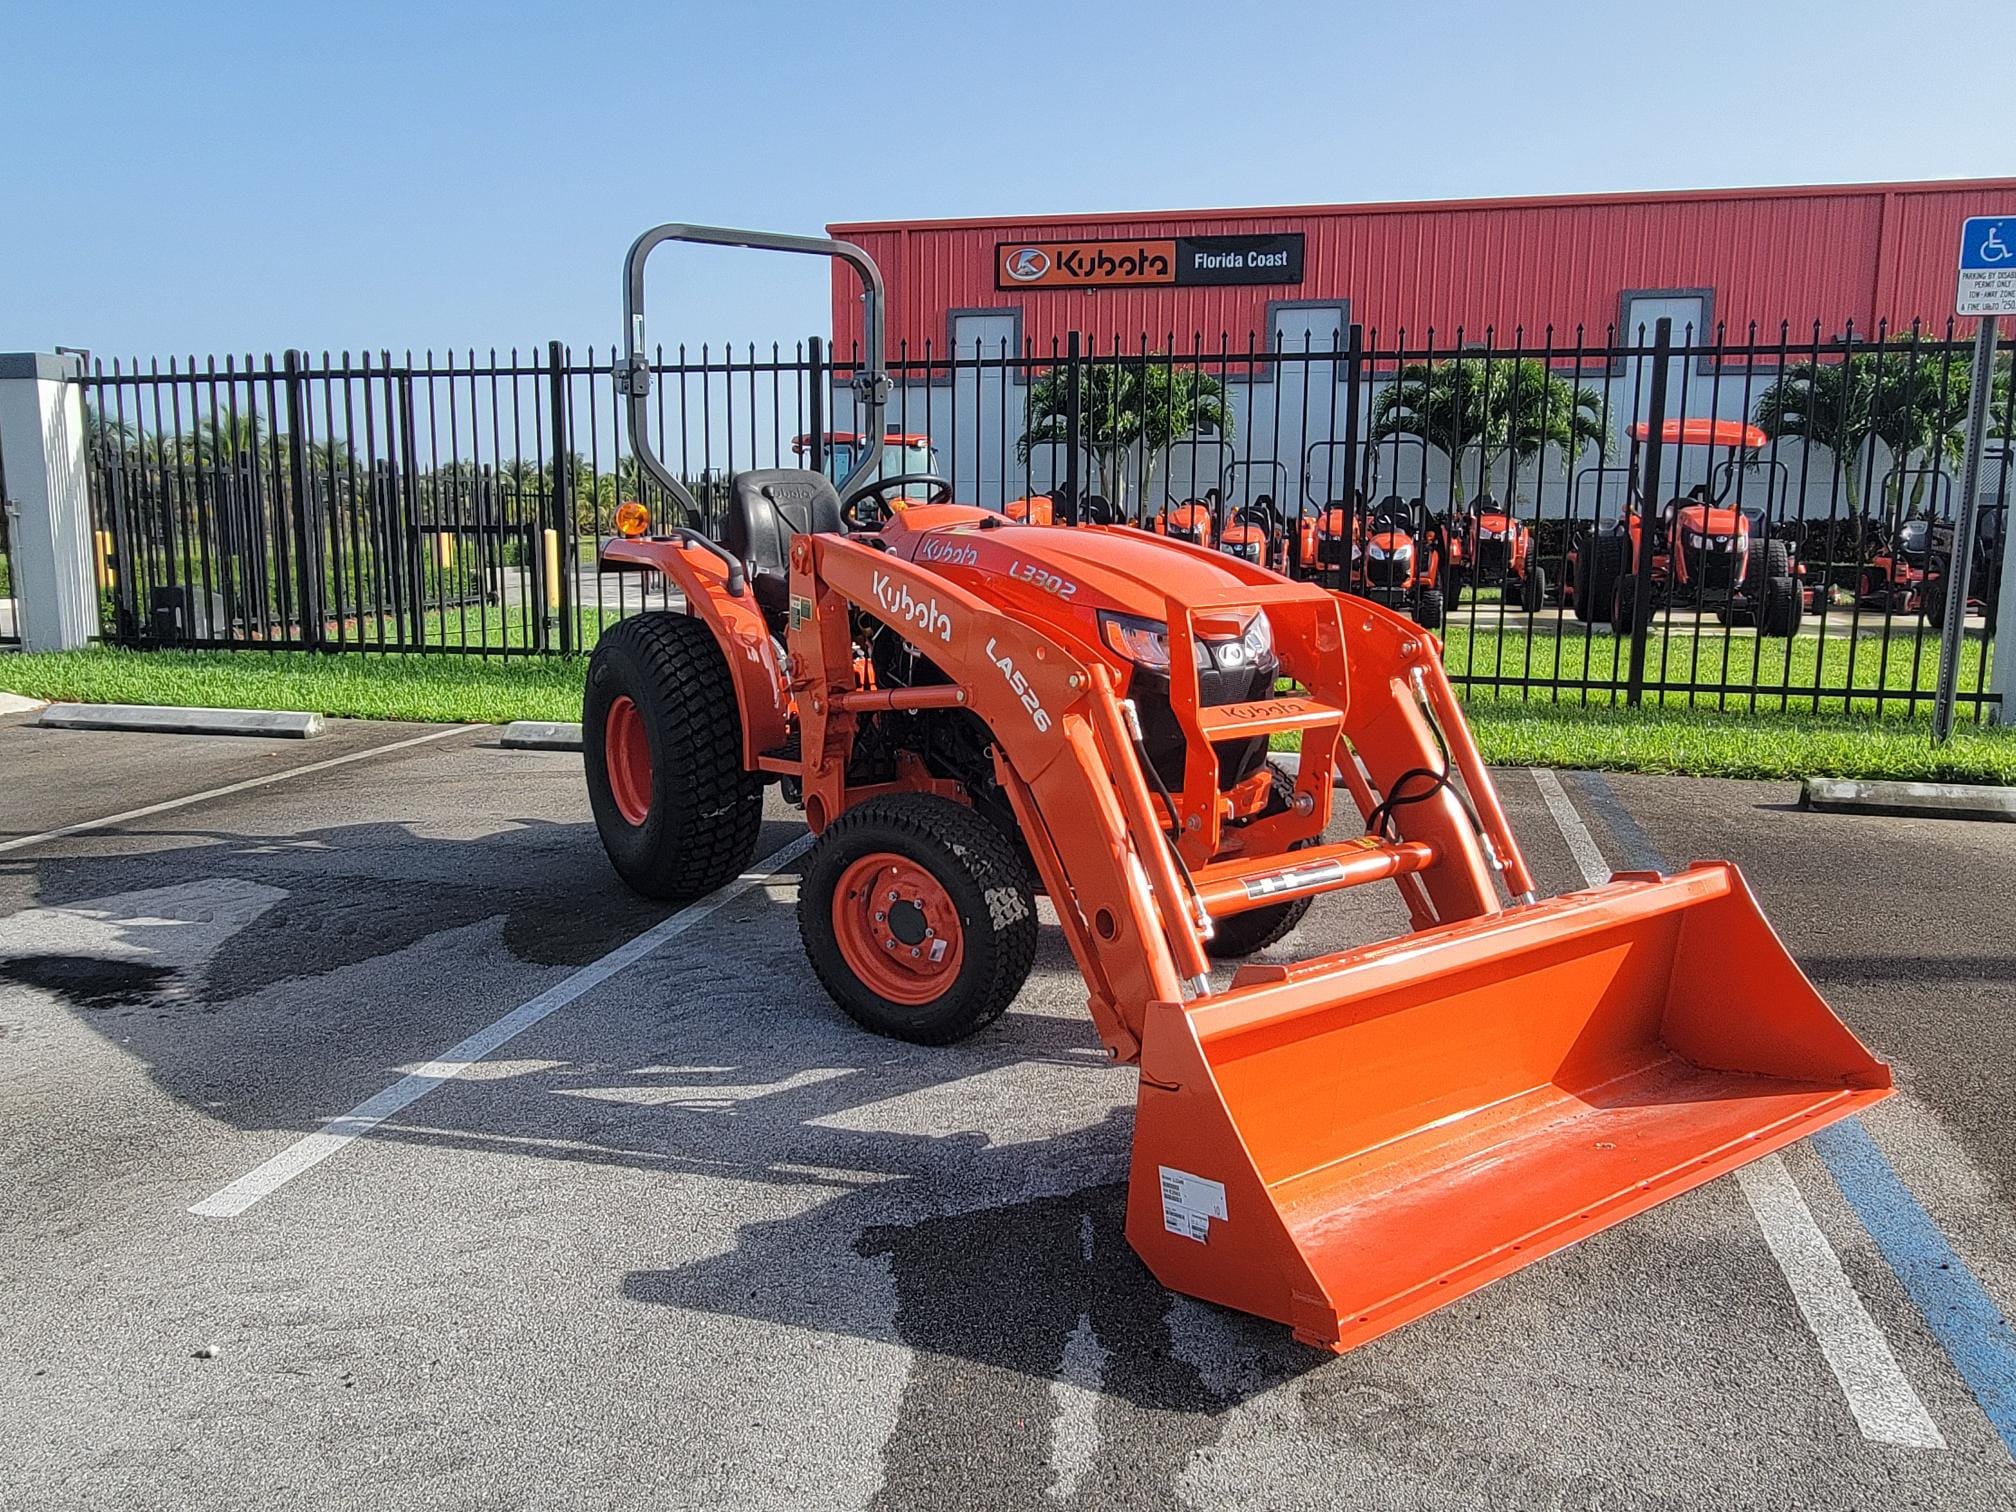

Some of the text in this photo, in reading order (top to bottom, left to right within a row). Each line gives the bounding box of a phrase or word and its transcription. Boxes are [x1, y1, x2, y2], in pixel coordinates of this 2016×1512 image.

[1056, 248, 1168, 277] Kubota
[1194, 250, 1288, 268] Florida Coast
[1962, 272, 1987, 280] PARKING
[1974, 280, 1996, 288] PERMIT
[922, 538, 978, 567] Kubota
[1008, 560, 1077, 601] L3302
[872, 570, 951, 642] Kubota
[985, 637, 1052, 733] LA526
[1220, 702, 1305, 719] Kubota
